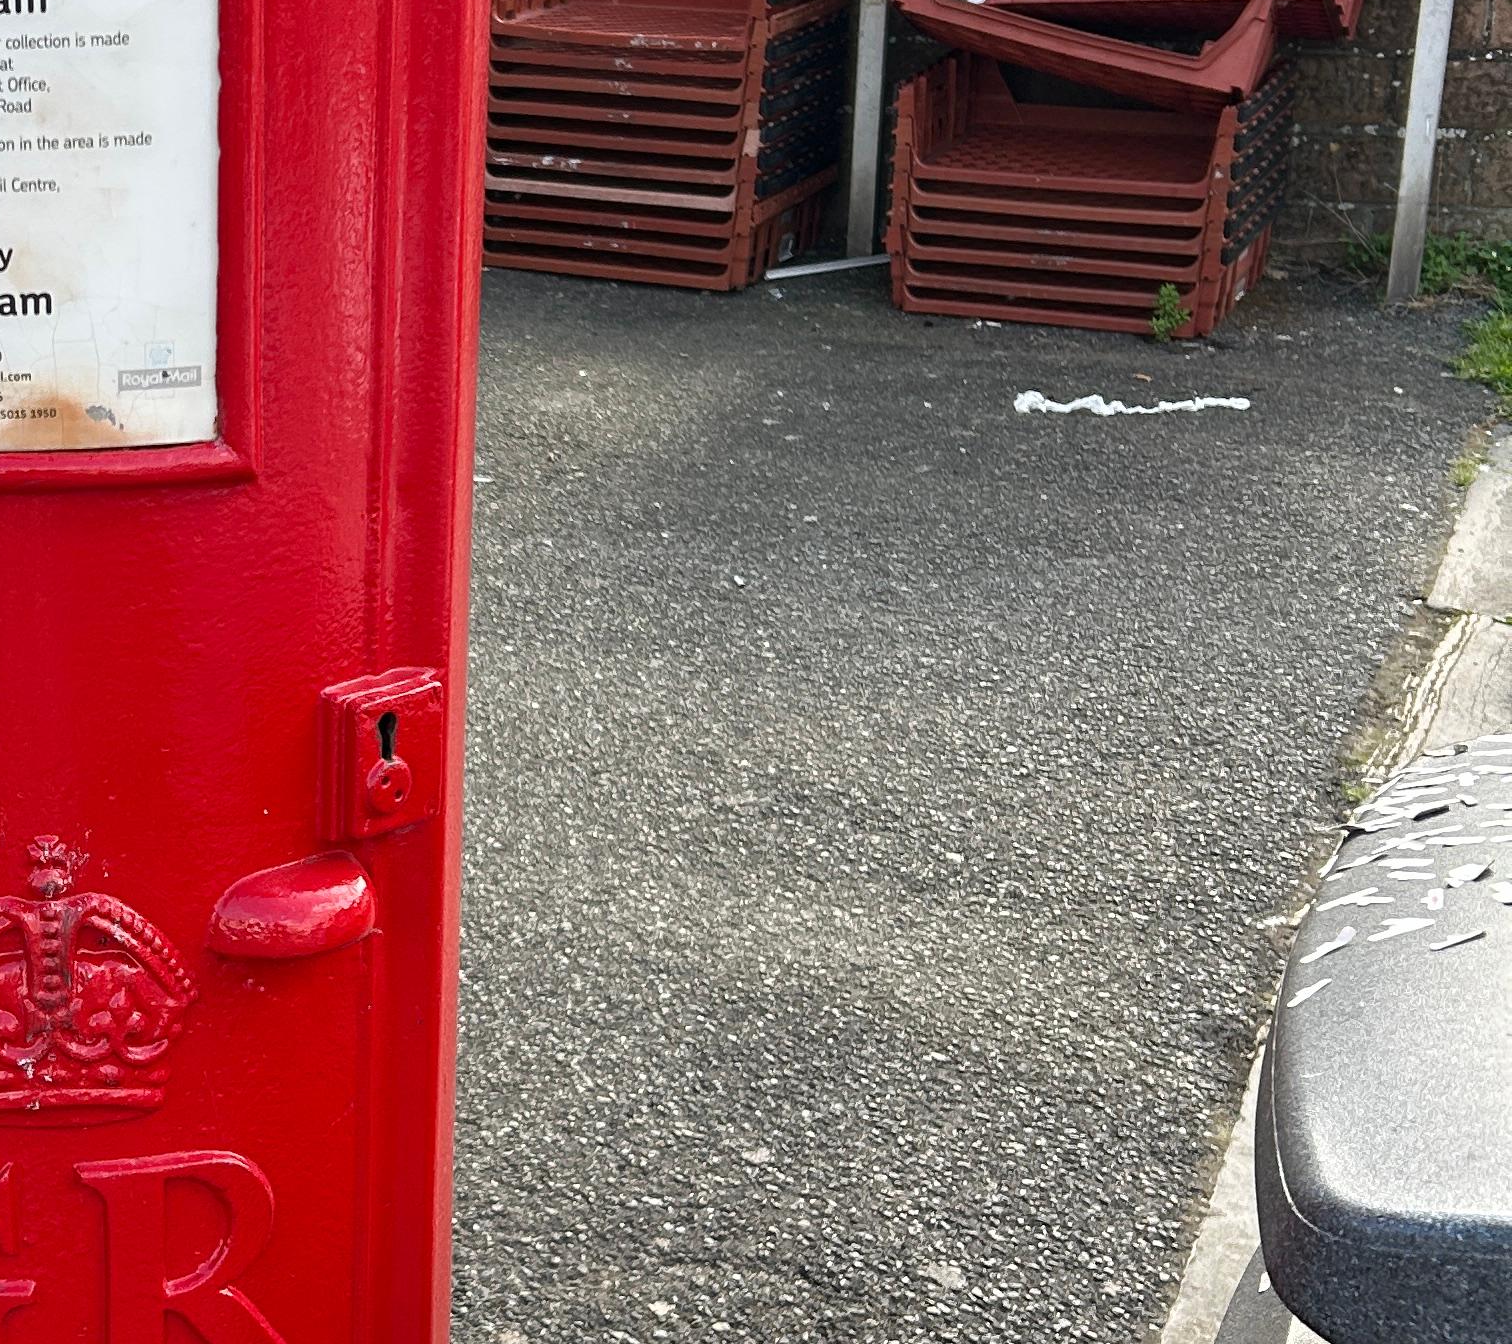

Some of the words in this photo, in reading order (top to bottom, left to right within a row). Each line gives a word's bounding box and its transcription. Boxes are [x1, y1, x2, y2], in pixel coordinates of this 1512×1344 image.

[5, 33, 71, 50] collection
[75, 33, 86, 47] is
[90, 31, 131, 47] made
[0, 57, 14, 71] at
[19, 136, 32, 151] in
[37, 134, 60, 150] the
[63, 135, 95, 150] area
[99, 132, 110, 148] is
[113, 131, 153, 147] made
[122, 369, 162, 387] Royal
[164, 367, 198, 383] Mail
